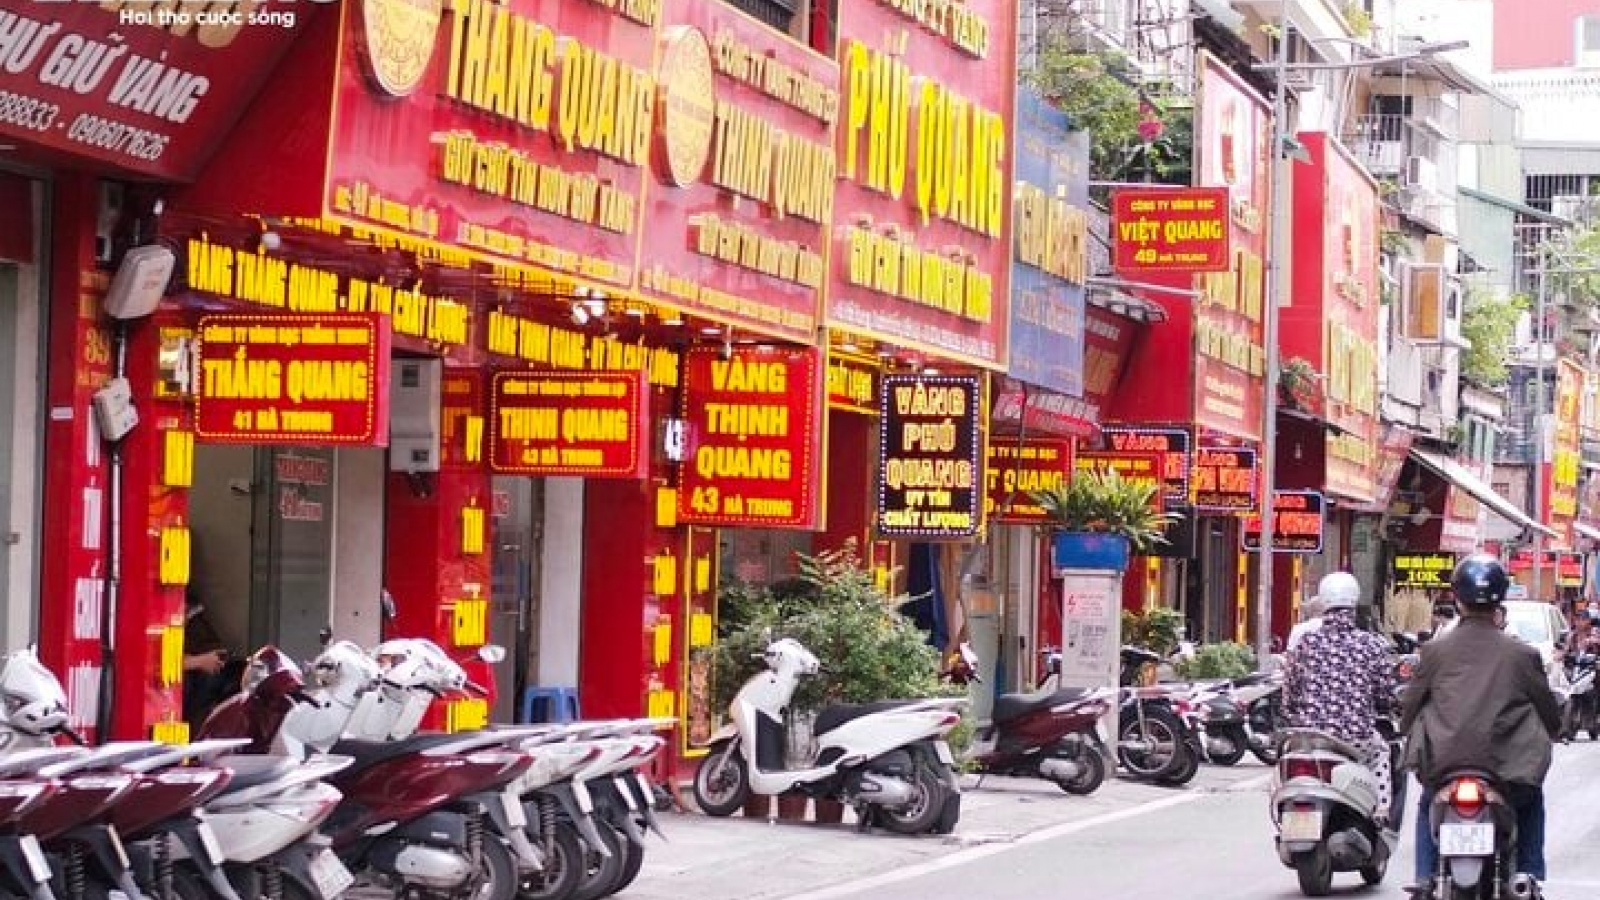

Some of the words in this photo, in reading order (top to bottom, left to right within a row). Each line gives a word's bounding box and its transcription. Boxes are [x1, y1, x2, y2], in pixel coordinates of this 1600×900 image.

[38, 31, 128, 94] GIỮ
[107, 50, 210, 123] VÀNG
[558, 36, 653, 166] QUANG
[846, 30, 910, 202] PHÚ
[916, 77, 1005, 240] QUANG
[775, 131, 836, 221] QUANG
[1119, 216, 1161, 247] VIỆT
[1164, 220, 1223, 244] QUANG
[188, 231, 233, 296] VÀNG
[288, 264, 338, 313] QUANG
[203, 345, 282, 398] THẮNG
[287, 360, 368, 403] QUANG
[710, 355, 787, 393] VÀNG
[895, 380, 965, 415] VÀNG
[256, 406, 279, 431] HÀ
[280, 411, 333, 433] TRUNG
[500, 407, 559, 446] THỊNH
[562, 408, 628, 443] QUANG
[704, 402, 789, 442] THỊNH
[903, 418, 957, 452] PHÚ
[560, 449, 603, 466] TRUNG
[697, 445, 792, 480] QUANG
[886, 458, 972, 490] QUANG
[691, 486, 719, 513] 43
[723, 493, 743, 515] HÀ
[746, 497, 793, 517] TRUNG
